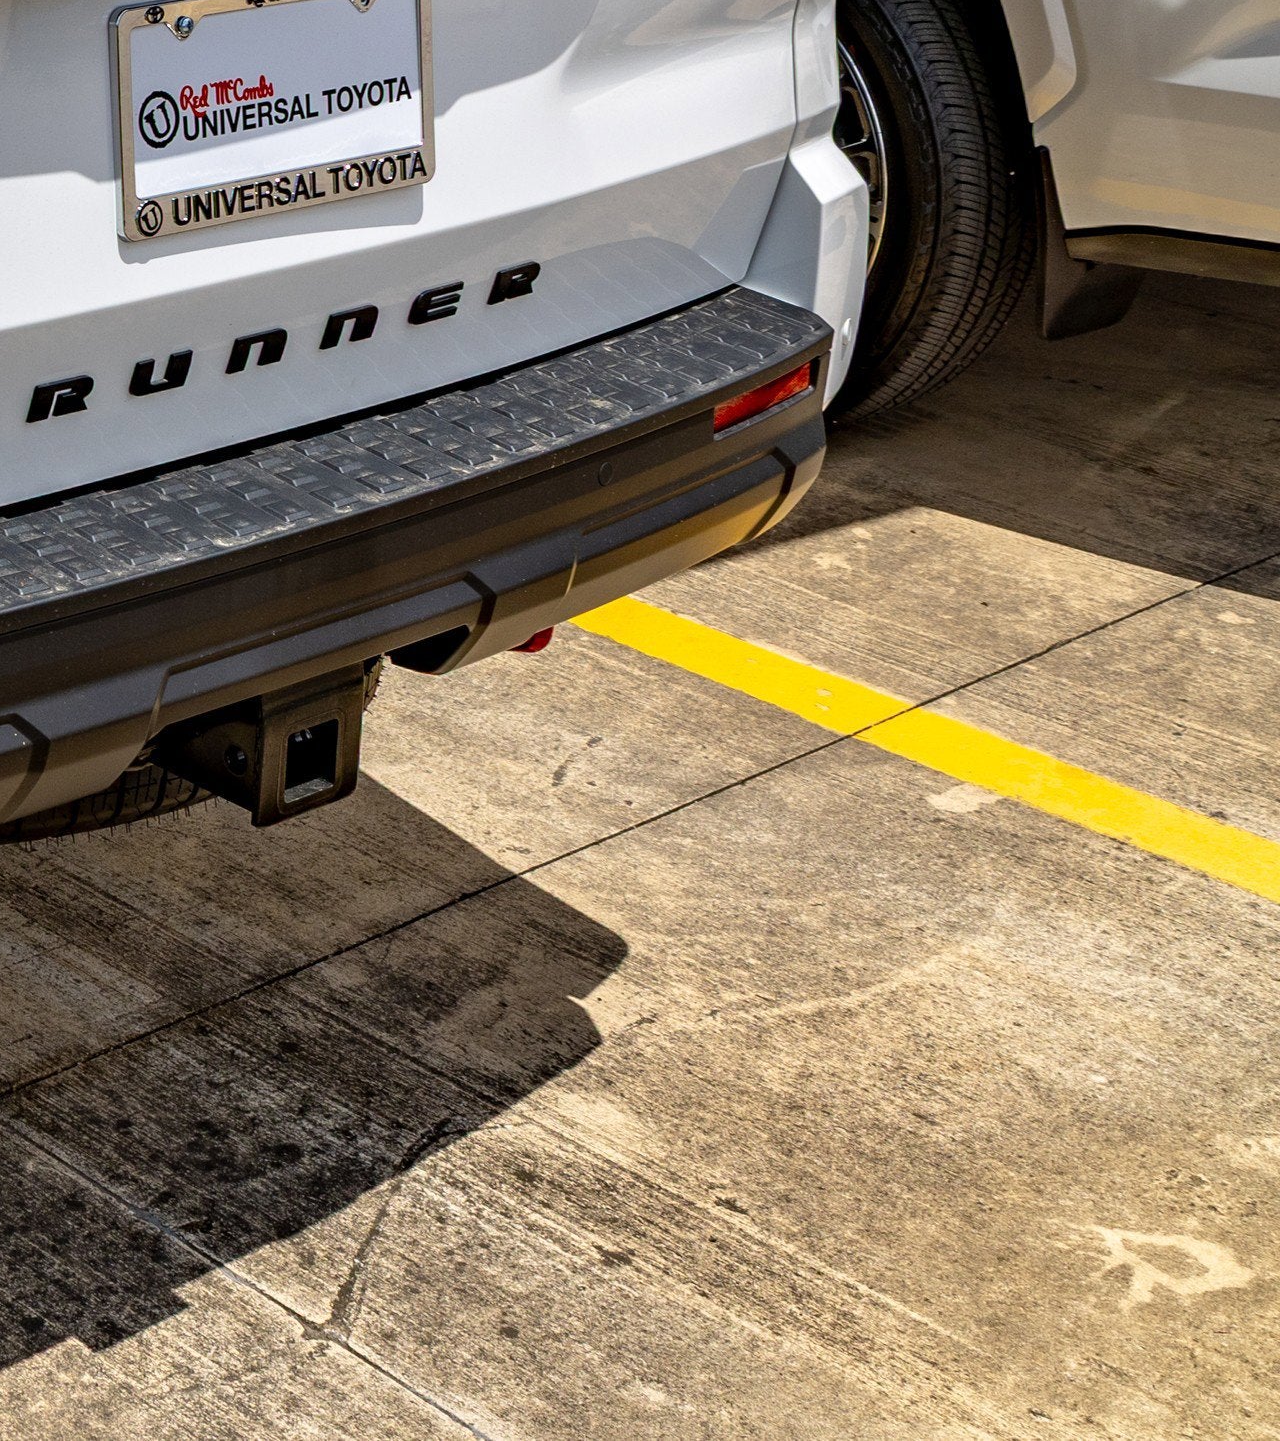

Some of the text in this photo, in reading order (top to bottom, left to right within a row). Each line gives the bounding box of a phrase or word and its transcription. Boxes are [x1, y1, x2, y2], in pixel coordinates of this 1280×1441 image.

[180, 75, 274, 118] Red McCombs
[182, 76, 412, 141] UNIVERSAL TOYOTA
[171, 150, 428, 226] UNIVERSAL TOYOTA
